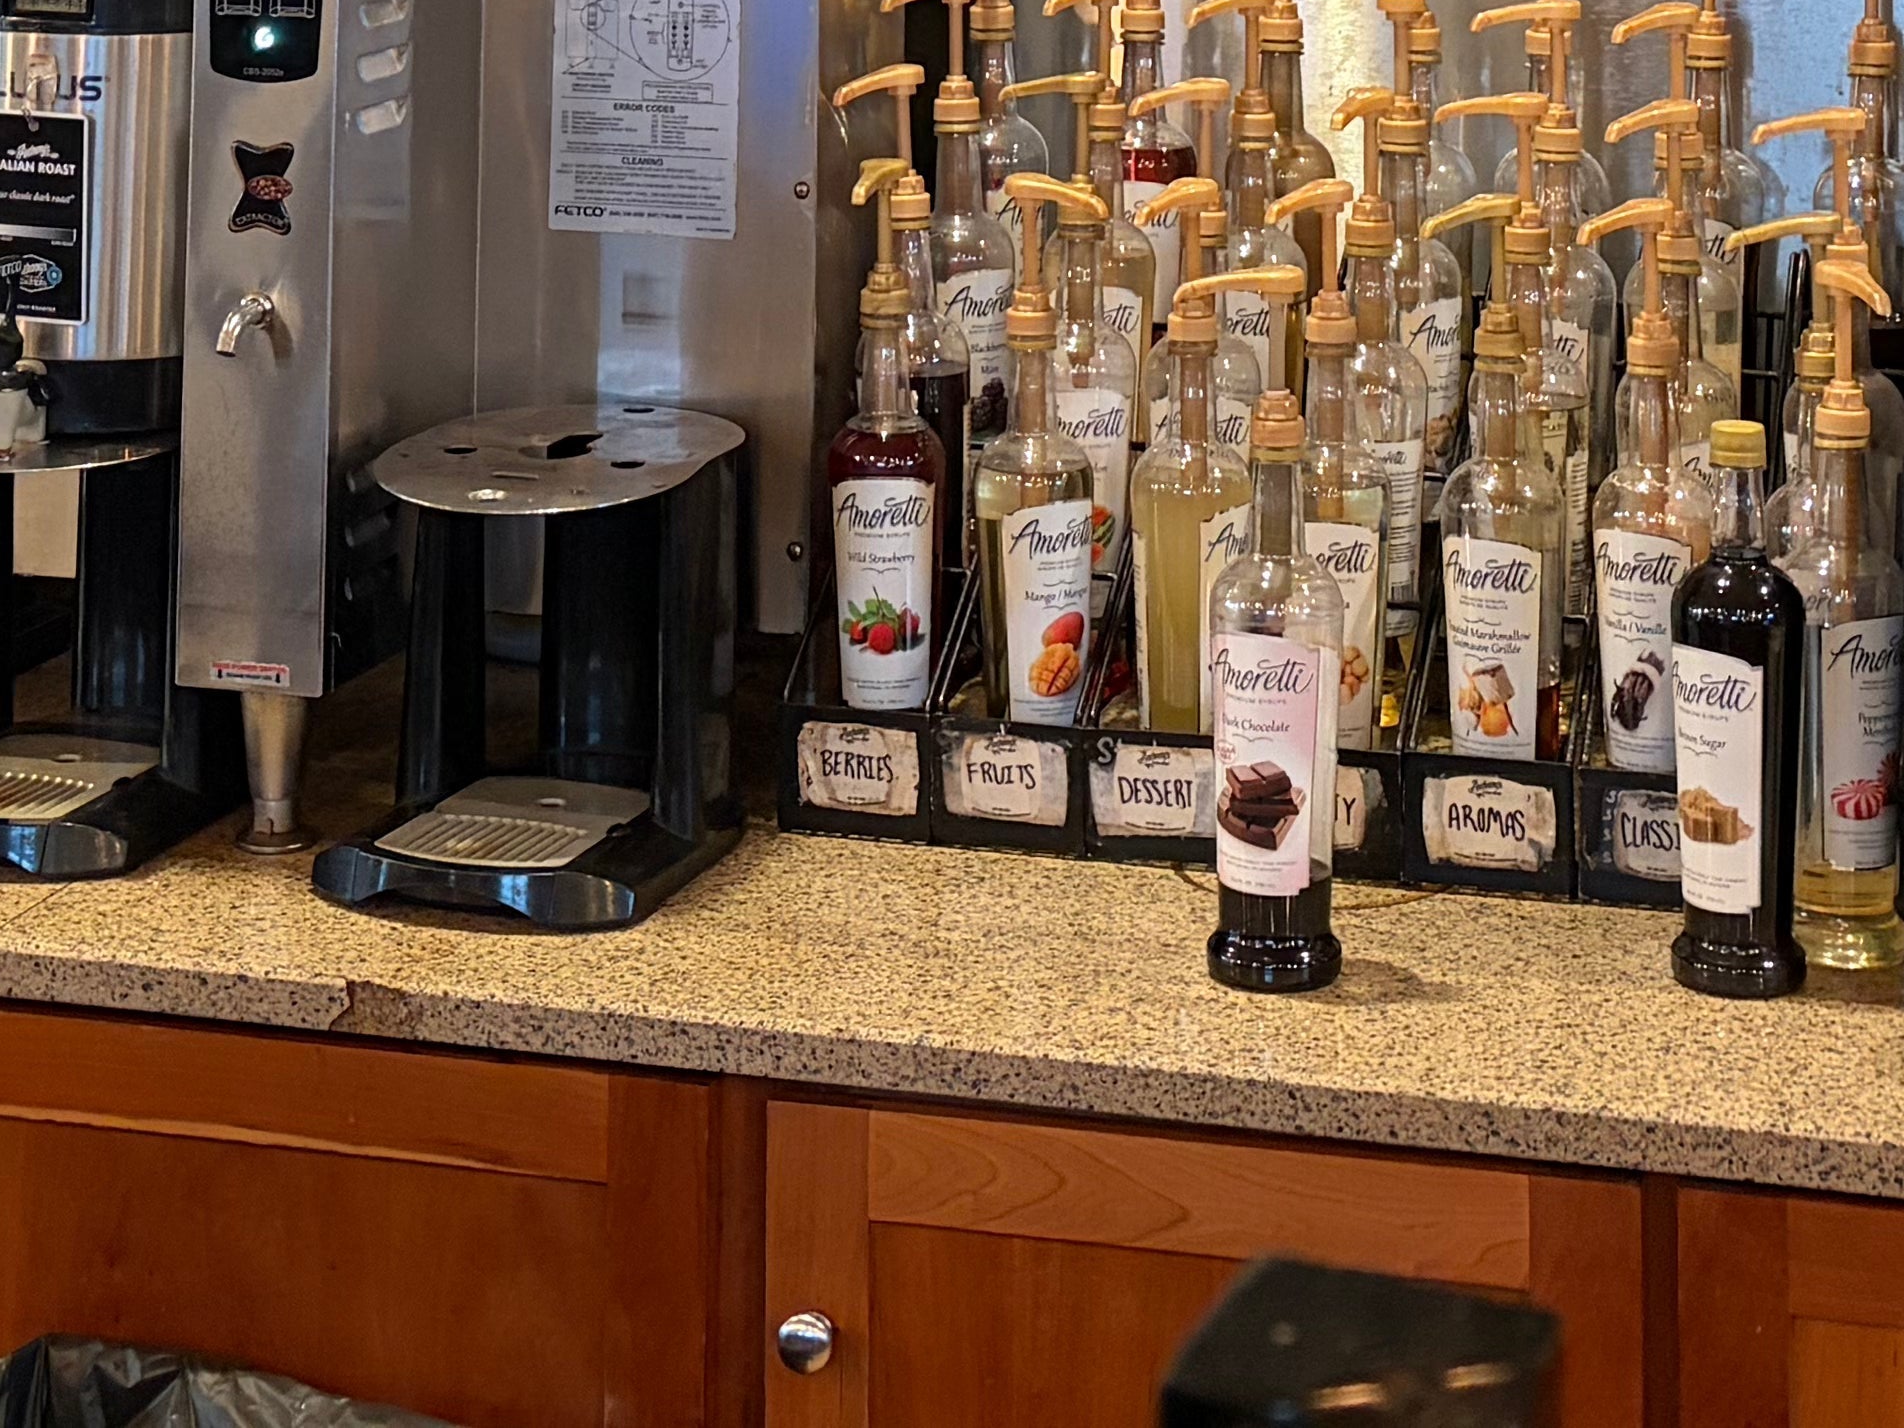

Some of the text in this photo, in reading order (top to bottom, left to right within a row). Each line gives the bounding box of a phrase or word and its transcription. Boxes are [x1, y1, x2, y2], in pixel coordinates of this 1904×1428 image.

[38, 160, 76, 176] ROAST
[835, 492, 931, 530] Amoretti
[1445, 549, 1538, 594] Amoretti
[1208, 647, 1314, 695] Amoretti
[820, 749, 894, 783] BERRIES
[966, 761, 1037, 790] FRUITS
[1117, 775, 1194, 809] DESSERT
[1447, 802, 1527, 841] AROMAS
